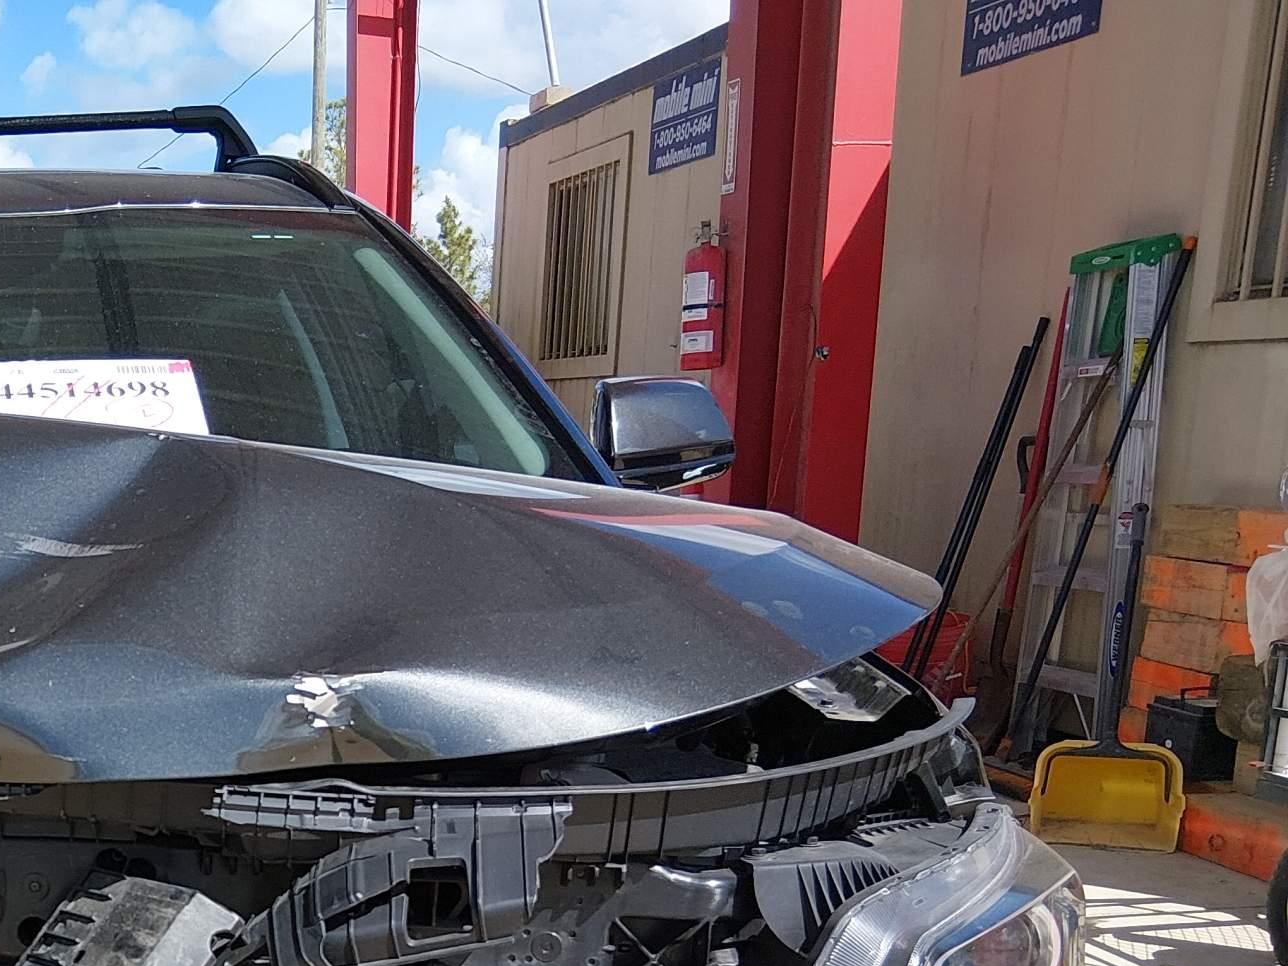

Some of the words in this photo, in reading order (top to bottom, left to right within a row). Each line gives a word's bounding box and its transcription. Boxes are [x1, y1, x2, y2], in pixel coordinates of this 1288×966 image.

[975, 14, 1082, 67] mobilemini.com
[653, 75, 691, 124] mobile
[689, 67, 720, 110] mini
[654, 113, 713, 151] 1-800-950-6464
[655, 141, 707, 169] mobilemini.com
